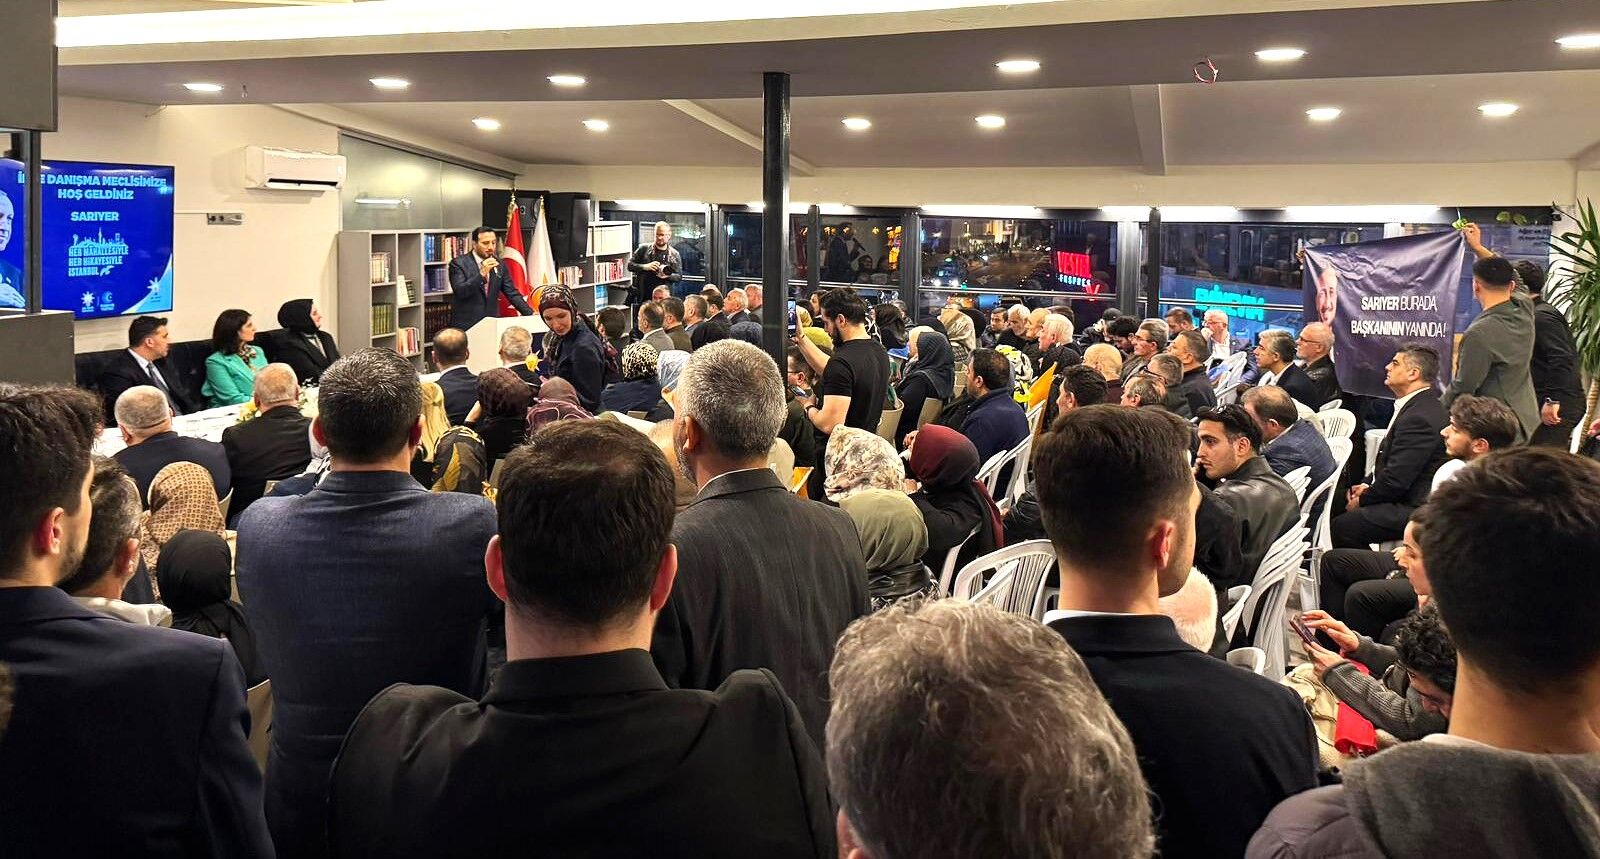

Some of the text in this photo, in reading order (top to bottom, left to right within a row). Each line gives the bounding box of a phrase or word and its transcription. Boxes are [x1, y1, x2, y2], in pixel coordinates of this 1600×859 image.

[47, 174, 100, 186] DANIŞMA
[102, 175, 166, 187] MECLİSİMİZE
[57, 188, 134, 200] HOŞ GELDİNİZ
[70, 211, 119, 221] SARIYER
[68, 247, 82, 256] HER
[68, 257, 82, 266] HER
[1361, 296, 1399, 310] SARIYER
[1351, 320, 1405, 337] BAŞKANININ
